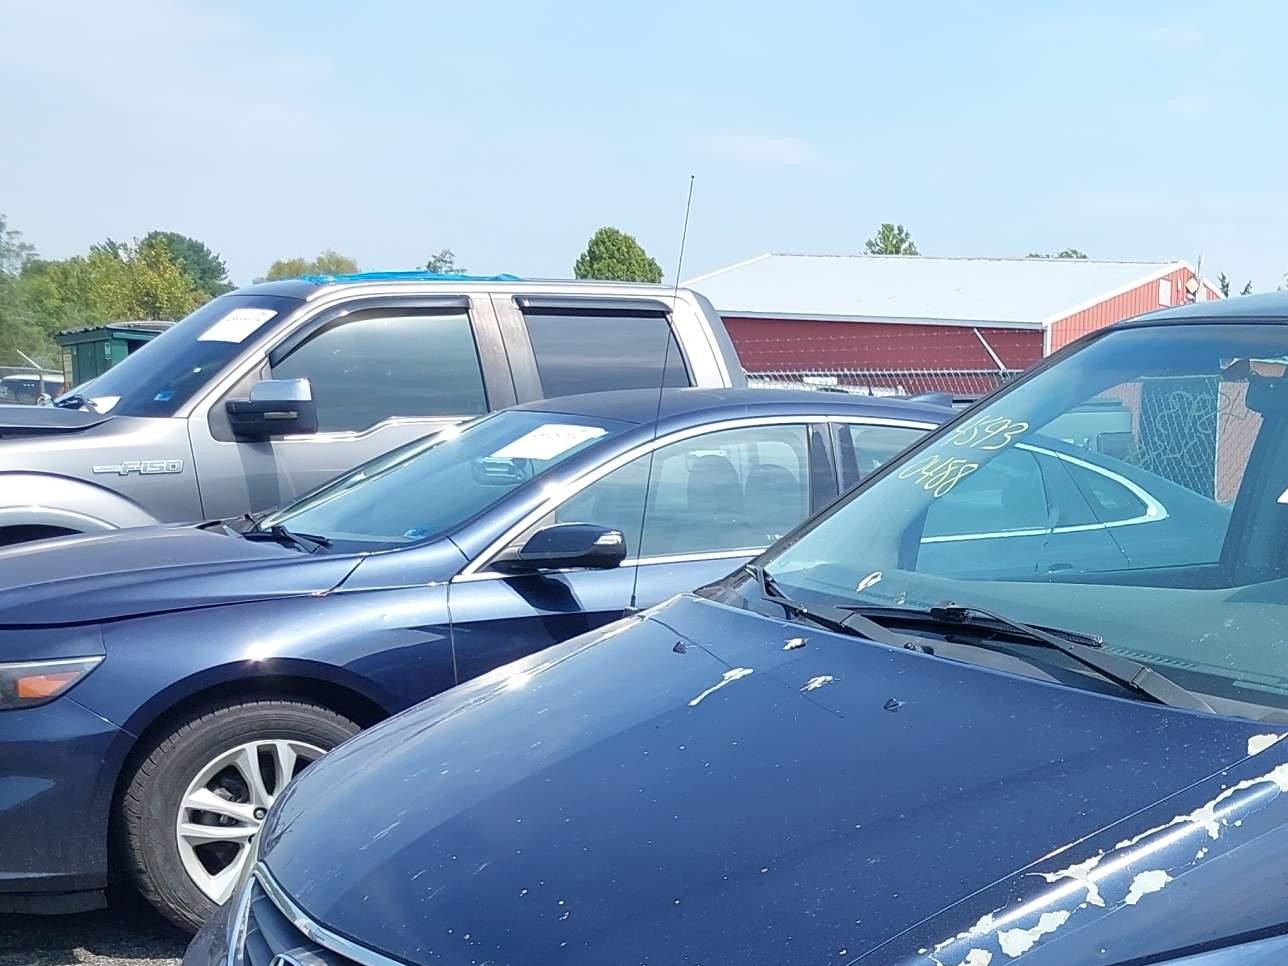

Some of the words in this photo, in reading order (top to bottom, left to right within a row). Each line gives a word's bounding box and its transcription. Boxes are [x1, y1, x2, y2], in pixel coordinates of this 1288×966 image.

[940, 415, 1029, 450] 4593
[120, 459, 184, 476] F-150
[899, 454, 979, 497] 0488
